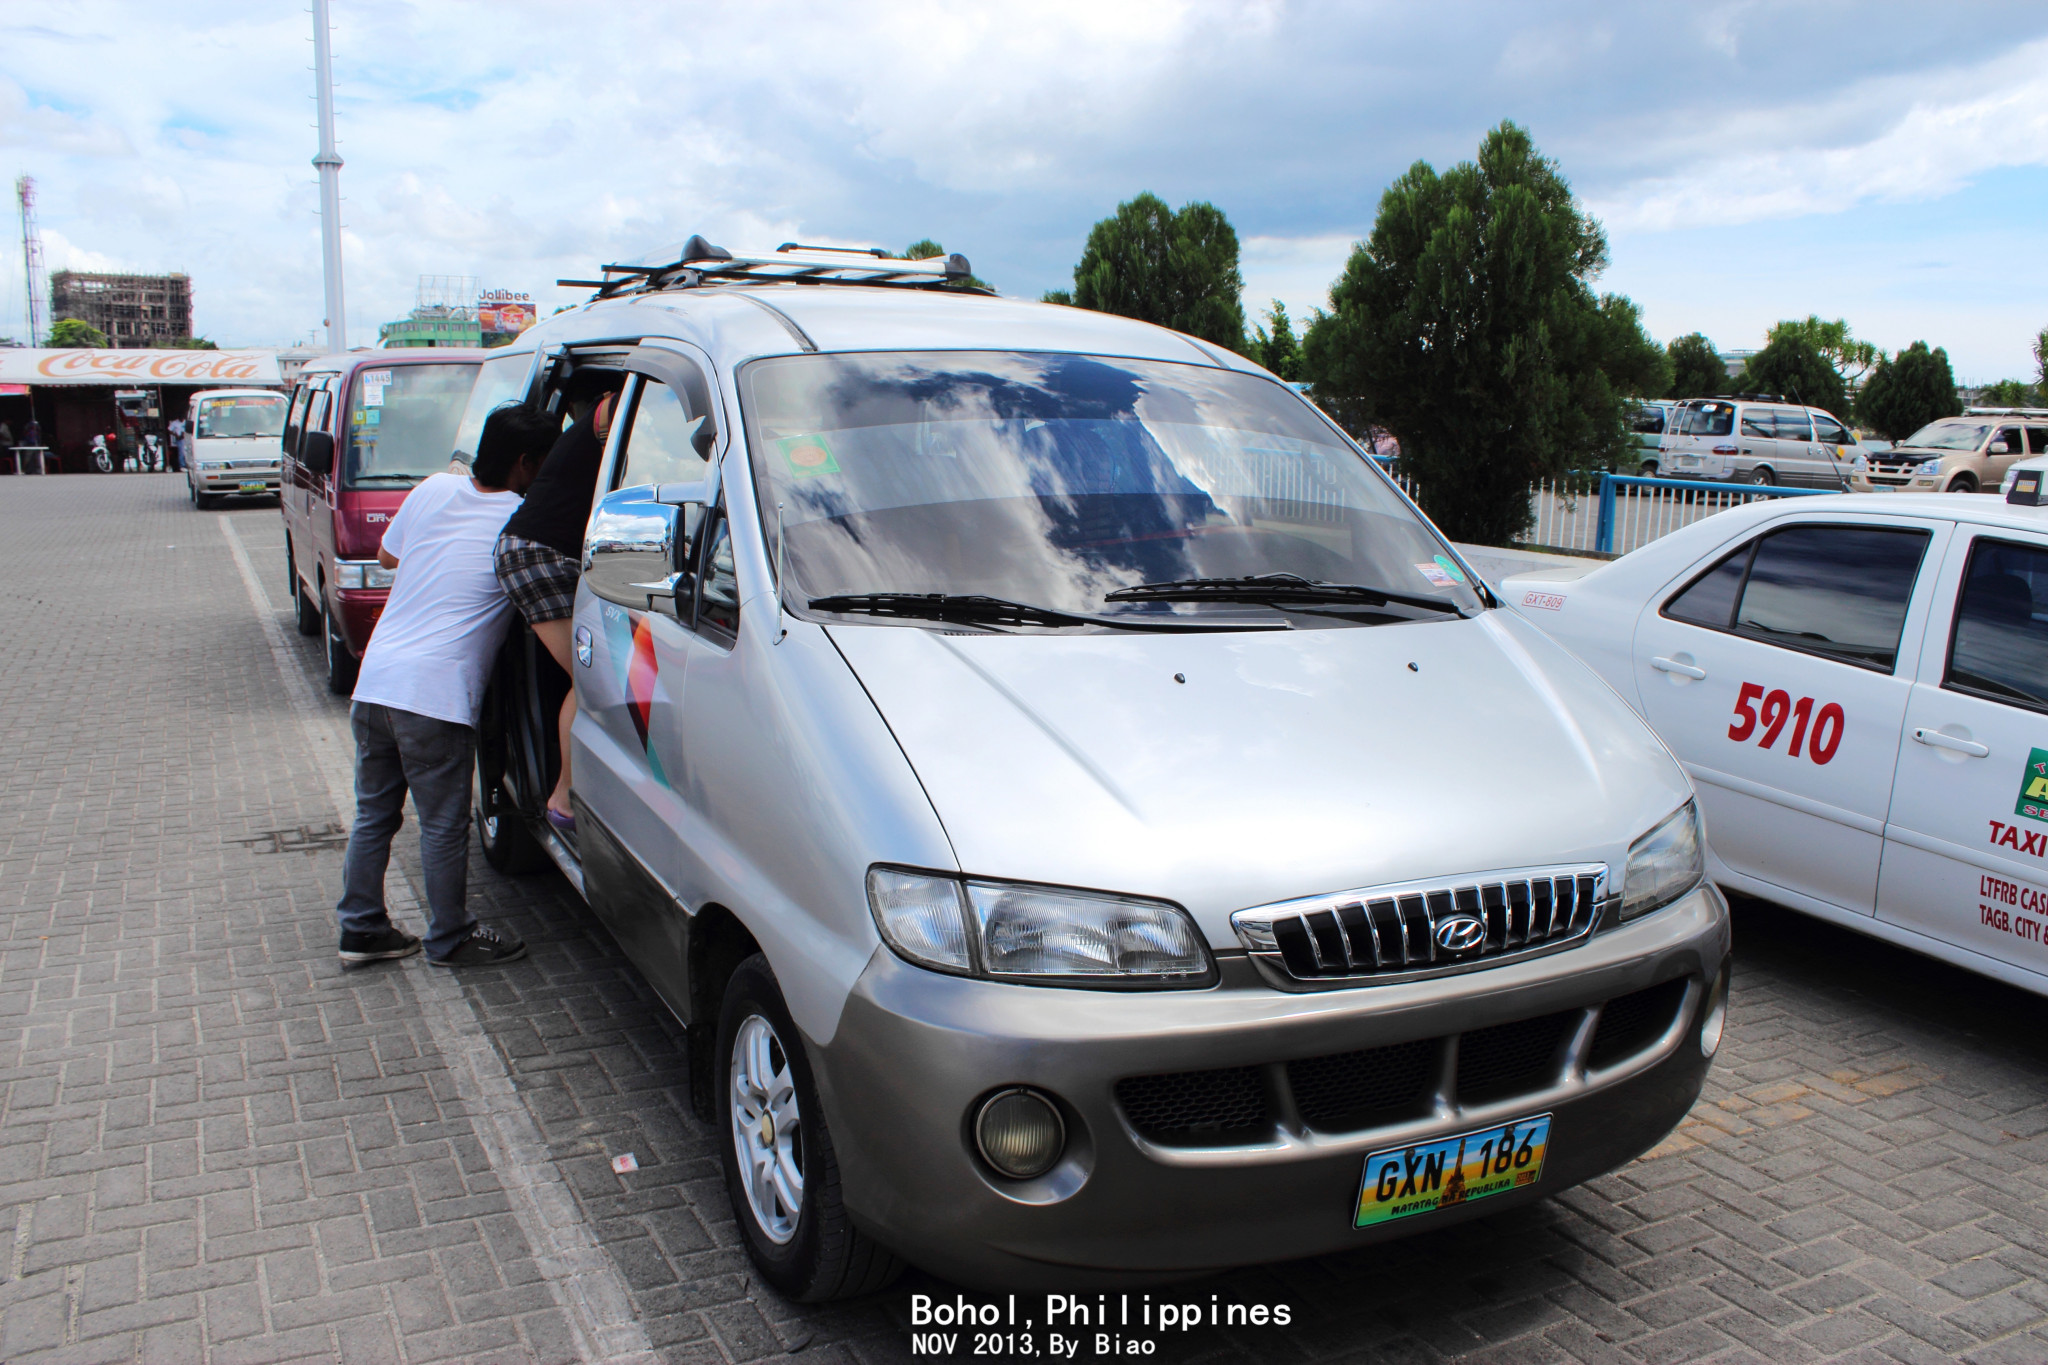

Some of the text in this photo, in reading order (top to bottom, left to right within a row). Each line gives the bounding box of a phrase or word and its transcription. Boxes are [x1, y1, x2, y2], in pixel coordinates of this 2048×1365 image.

[478, 288, 530, 301] Jollibee
[1727, 681, 1845, 765] 5910
[1989, 820, 2048, 858] TAXI
[1980, 874, 2048, 917] LTFRB CAS
[1979, 903, 2013, 934] TAGB.
[2014, 915, 2042, 943] CITY
[1376, 1127, 1538, 1204] GXN 186
[1391, 1197, 1440, 1216] MATATAG
[1459, 1178, 1511, 1200] REPUBLIKA
